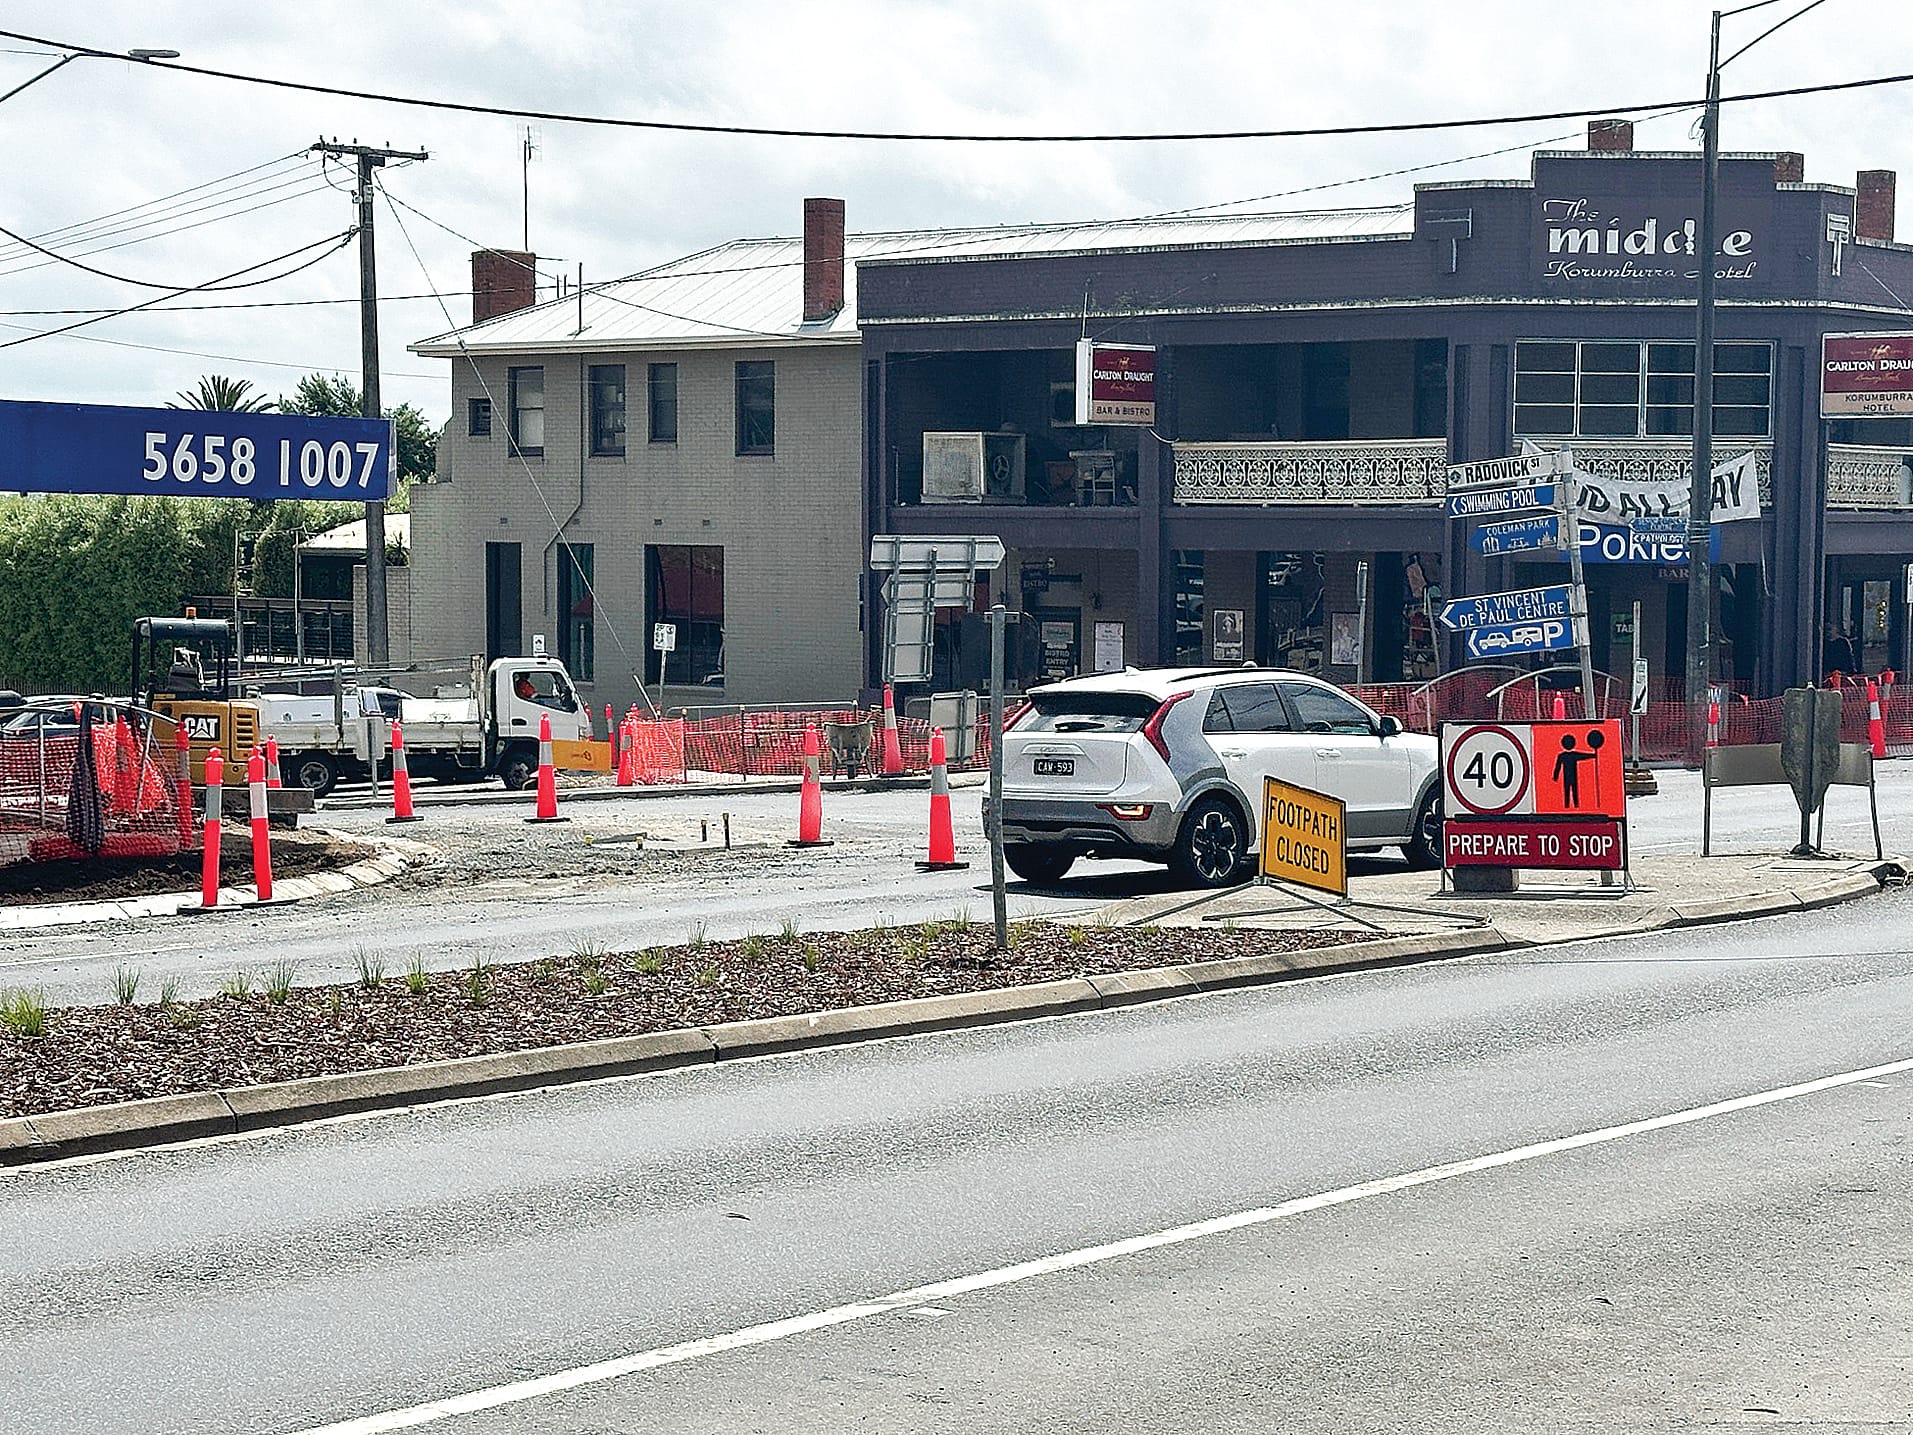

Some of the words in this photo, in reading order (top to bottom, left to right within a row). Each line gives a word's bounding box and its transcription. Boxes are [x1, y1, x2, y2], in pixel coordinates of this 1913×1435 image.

[1543, 199, 1600, 222] The
[1549, 217, 1752, 256] midde
[1544, 261, 1676, 280] Korumburra
[1093, 369, 1122, 381] CARLTON
[1124, 371, 1154, 382] DRAUGHT
[1826, 360, 1875, 371] CARLTON
[1880, 359, 1913, 370] DRAU
[1845, 393, 1913, 402] KORUMBURRA
[1863, 403, 1895, 412] HOTEL
[1096, 406, 1113, 415] BAR
[1115, 406, 1120, 415] &
[1122, 406, 1151, 416] BISTRO
[144, 432, 256, 485] 5658
[280, 440, 379, 488] 1007
[1465, 459, 1530, 484] RADOVICK
[1531, 458, 1540, 468] ST
[1460, 492, 1510, 514] SWIMMING
[1512, 488, 1539, 508] POOL
[1619, 492, 1680, 518] ALL
[1486, 522, 1526, 536] COLEMAN
[1528, 520, 1550, 531] PARK
[1475, 599, 1489, 613] ST
[1494, 591, 1546, 610] VINCENT
[1460, 613, 1476, 628] DE
[1480, 609, 1513, 625] PAUL
[1517, 601, 1565, 618] CENTRE
[1544, 621, 1564, 648] P
[184, 717, 219, 739] CAT
[1463, 752, 1513, 789] 40
[1269, 796, 1337, 842] FOOTPATH
[1277, 836, 1329, 875] CLOSED
[1449, 834, 1530, 856] PREPARE
[1537, 835, 1560, 856] TO
[1569, 835, 1613, 857] STOP
